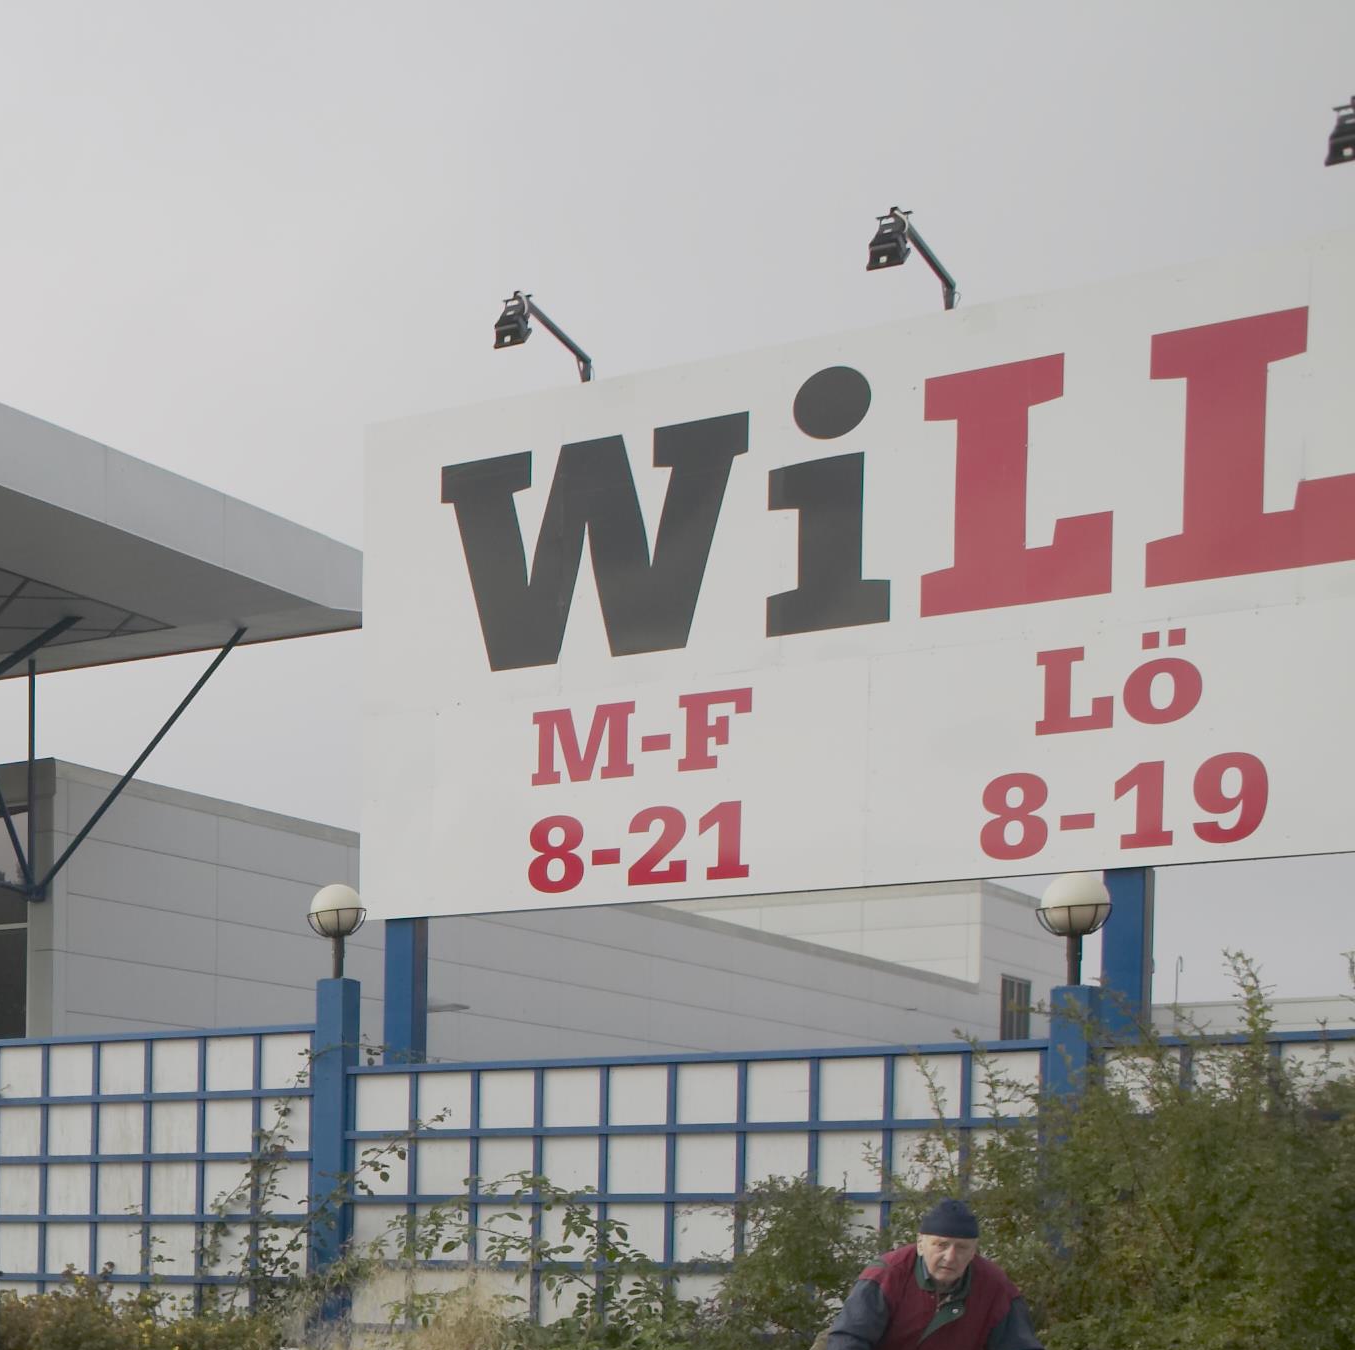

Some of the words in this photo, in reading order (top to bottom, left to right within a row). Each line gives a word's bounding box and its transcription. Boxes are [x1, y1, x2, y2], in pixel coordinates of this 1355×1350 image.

[1035, 628, 1203, 736] Lö
[532, 687, 752, 786] M-F
[527, 801, 750, 893] 8-21
[980, 752, 1270, 860] 8-19
